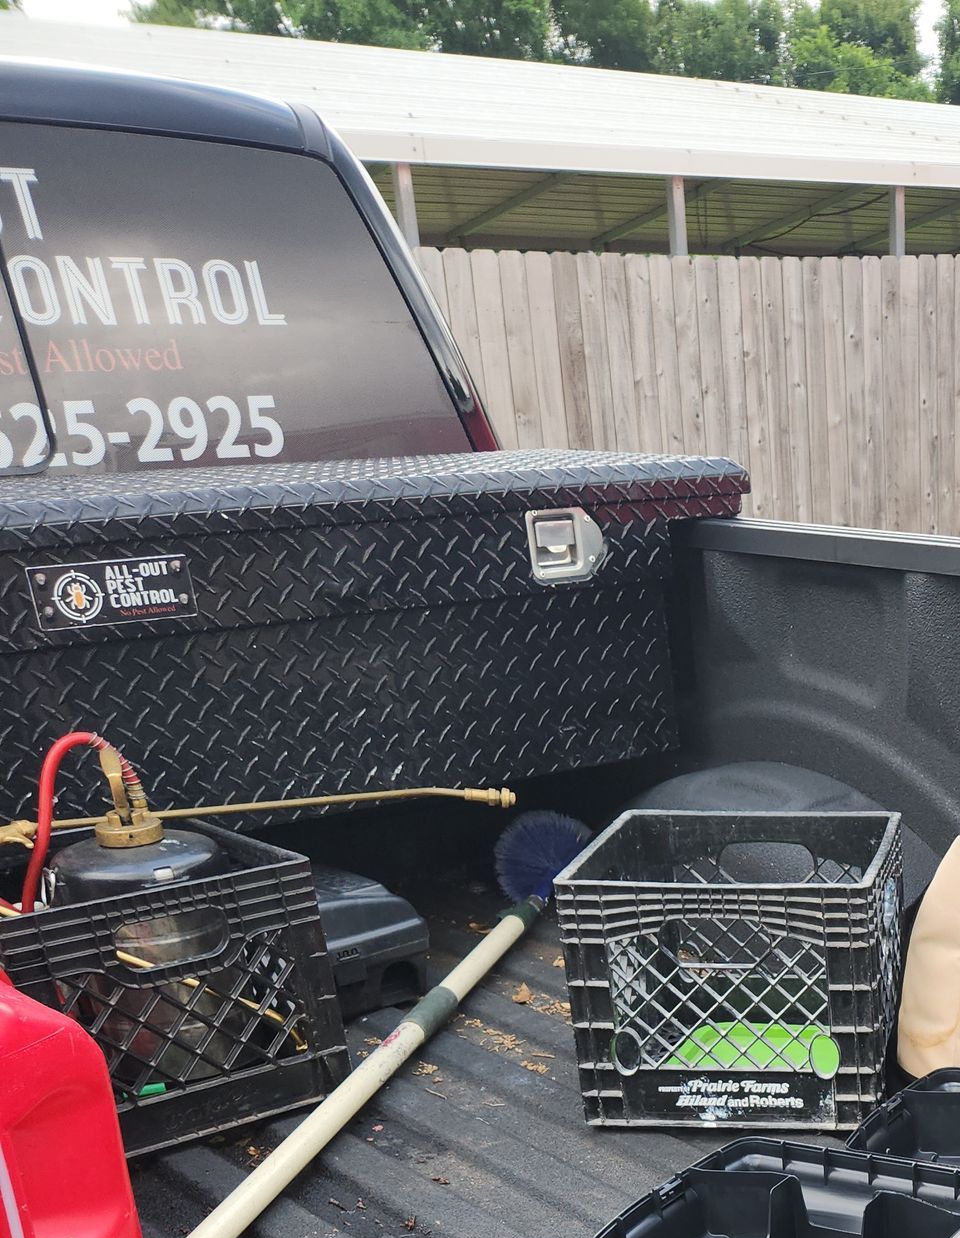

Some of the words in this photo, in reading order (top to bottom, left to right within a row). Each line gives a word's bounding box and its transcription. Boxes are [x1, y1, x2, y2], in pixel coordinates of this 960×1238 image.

[0, 168, 43, 240] T
[0, 255, 287, 326] ONTROL
[45, 338, 184, 373] Allowed
[105, 561, 168, 580] ALL-OUT
[105, 577, 144, 594] PEST
[110, 588, 179, 609] CONTROL
[688, 1080, 740, 1093] Prairie
[740, 1080, 790, 1095] Farms
[727, 1096, 749, 1107] and
[749, 1094, 804, 1108] Roberts
